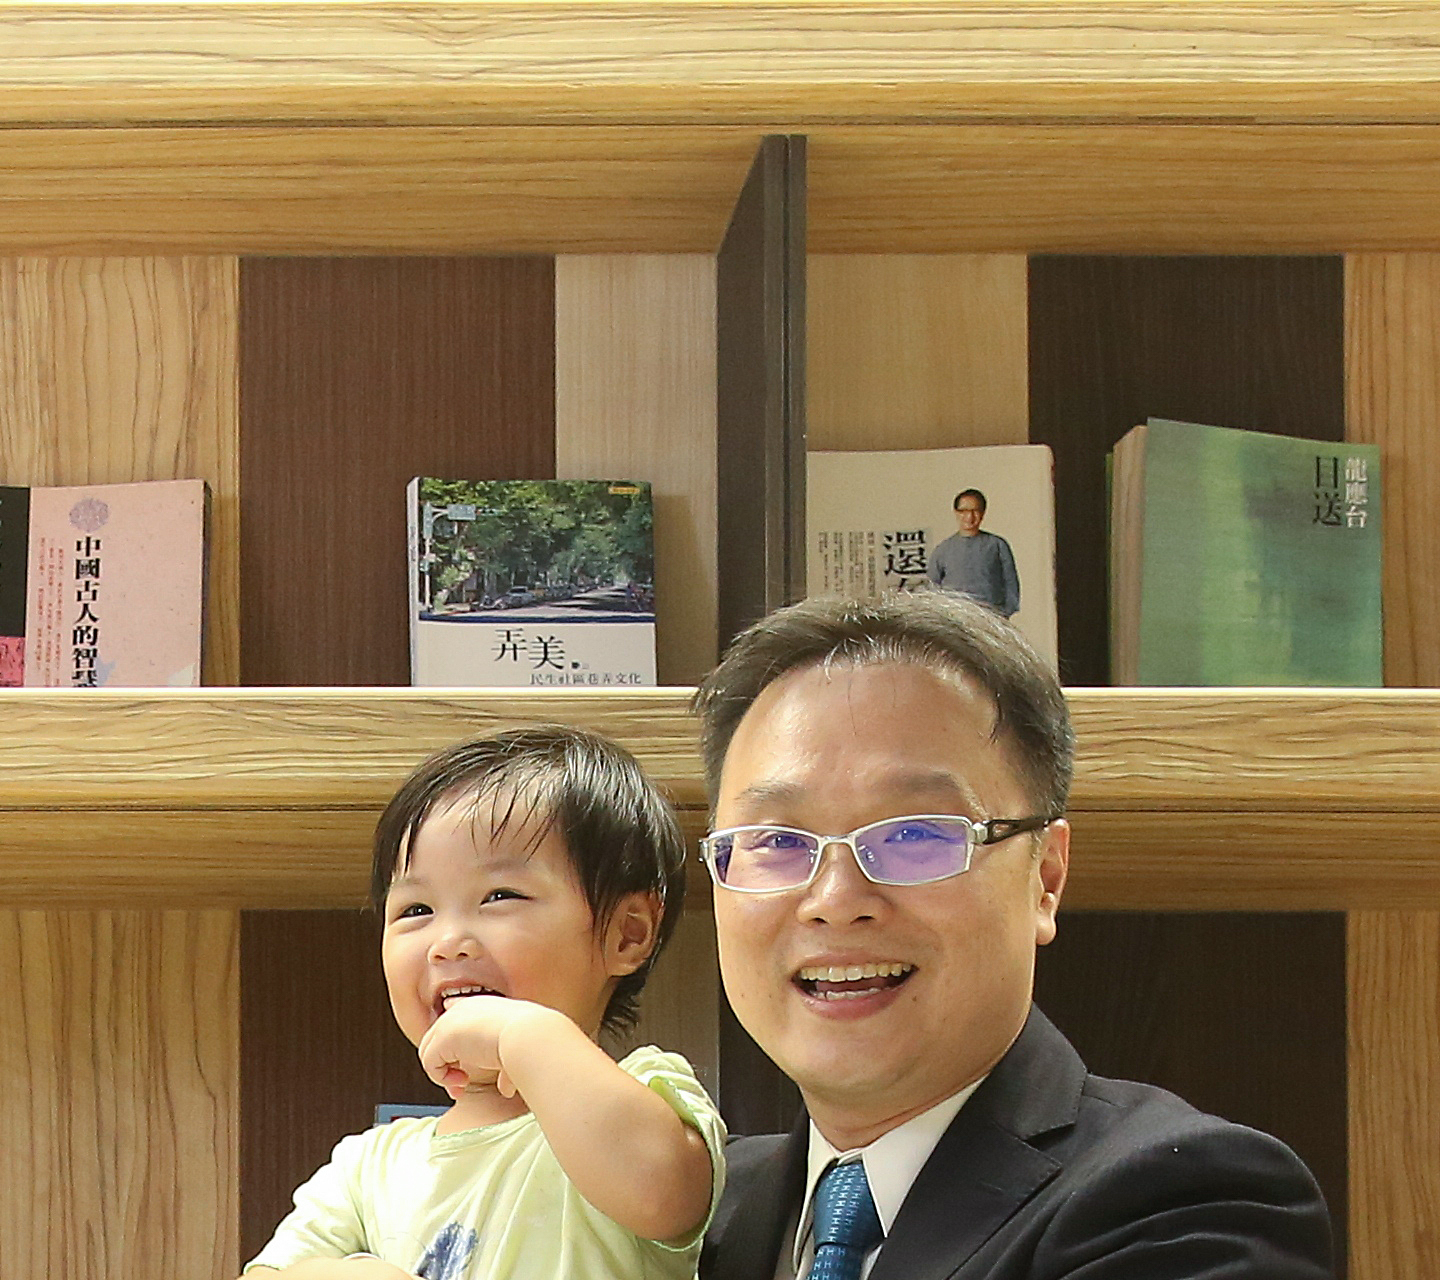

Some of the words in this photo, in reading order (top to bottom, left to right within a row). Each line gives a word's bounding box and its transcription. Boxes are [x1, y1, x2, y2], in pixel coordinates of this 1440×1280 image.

[1312, 456, 1343, 527] 目送
[71, 536, 102, 687] 中國古人的智慧
